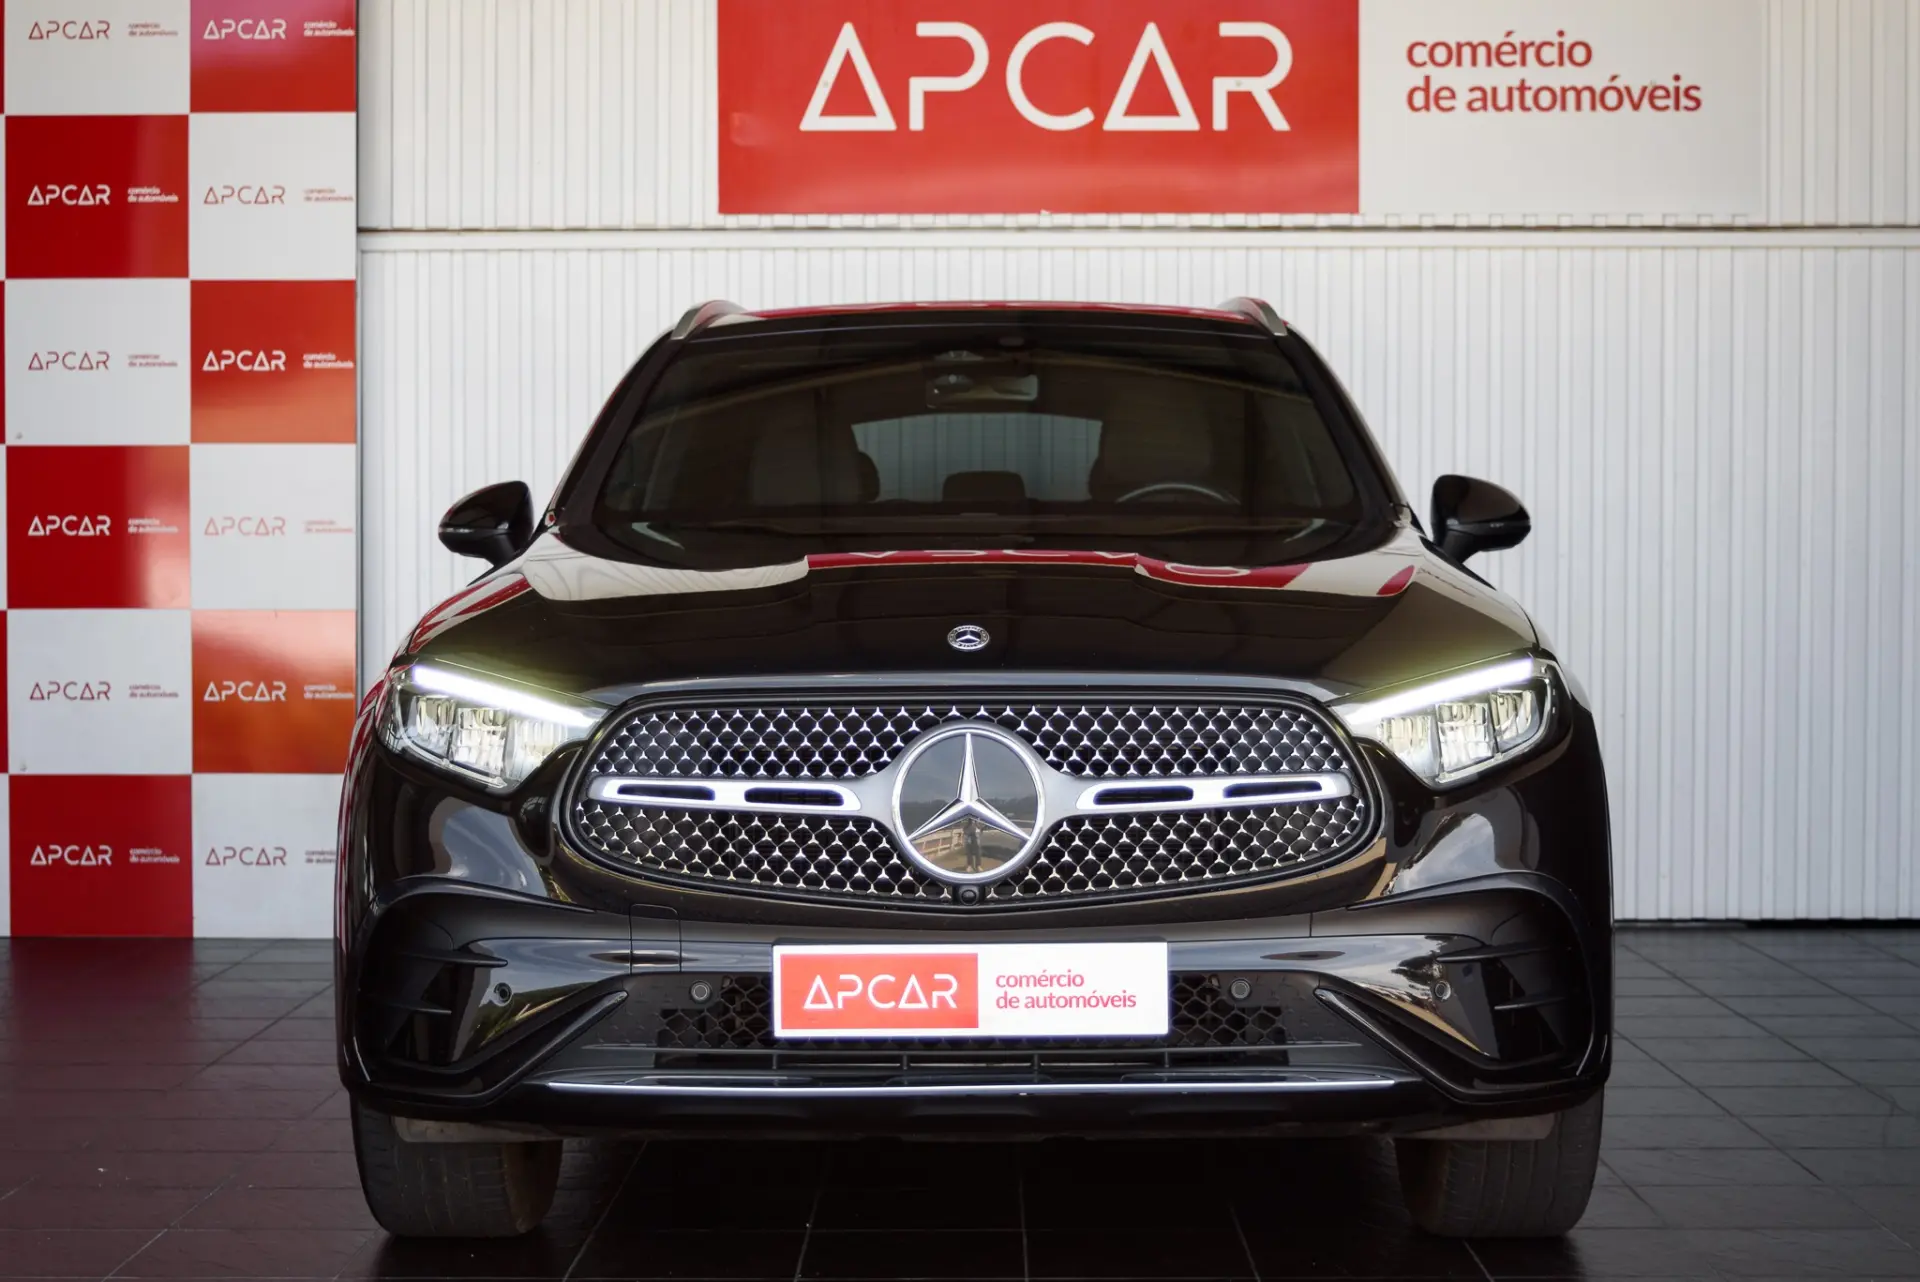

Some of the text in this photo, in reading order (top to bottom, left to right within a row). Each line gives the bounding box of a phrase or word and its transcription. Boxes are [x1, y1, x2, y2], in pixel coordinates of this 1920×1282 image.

[29, 21, 110, 40] APCAR
[204, 19, 286, 39] APCAR
[1407, 30, 1592, 67] comércio
[800, 22, 1292, 131] APCAR
[1407, 74, 1702, 112] de automóveis
[28, 185, 110, 205] APCAR
[204, 186, 285, 204] APCAR
[28, 352, 109, 370] APCAR
[203, 350, 286, 371] APCAR
[28, 515, 110, 536] APCAR
[204, 517, 285, 536] APCAR
[30, 682, 110, 700] APCAR
[204, 681, 286, 701] APCAR
[31, 845, 112, 865] APCAR
[206, 847, 286, 866] APCAR
[996, 969, 1085, 988] comércio
[804, 974, 958, 1009] APCAR
[996, 990, 1137, 1009] de automóveis
